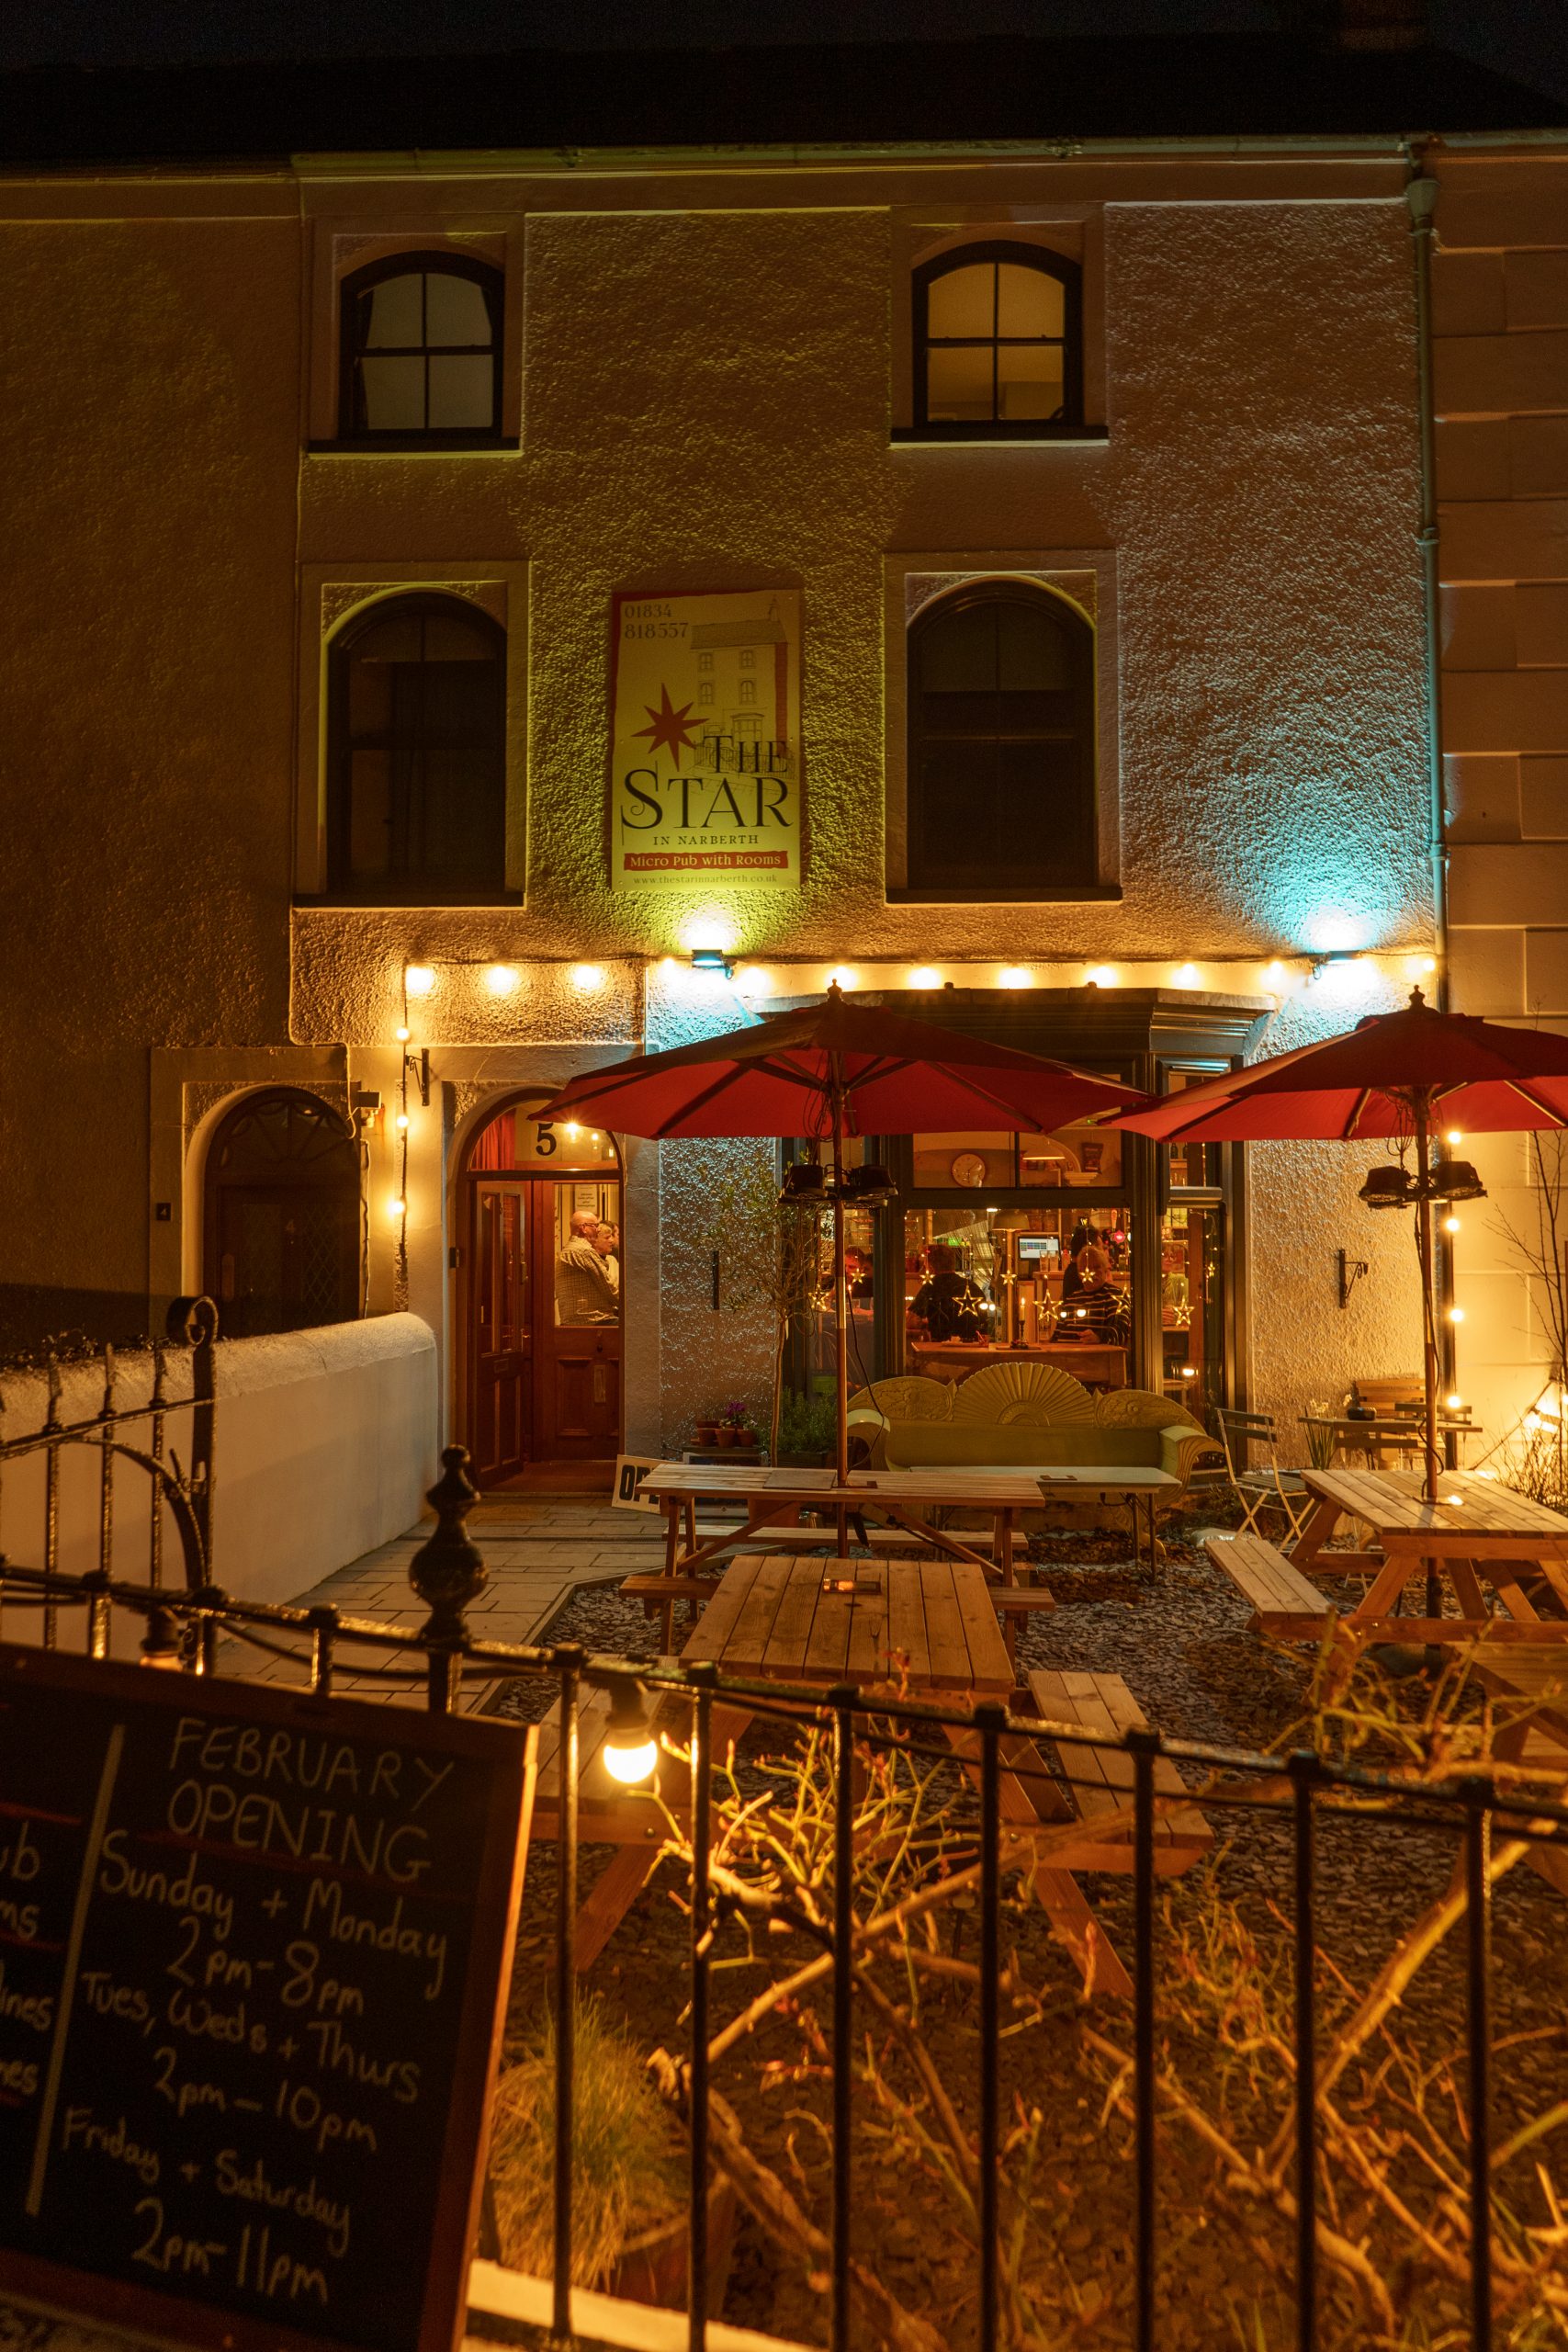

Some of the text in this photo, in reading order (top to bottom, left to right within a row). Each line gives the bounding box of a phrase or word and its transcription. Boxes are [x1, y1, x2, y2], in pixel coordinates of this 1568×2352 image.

[625, 604, 671, 618] 01834
[703, 735, 788, 774] THE
[620, 763, 795, 836] STAR
[630, 854, 781, 867] Micro Pub with Rooms
[653, 834, 759, 846] IN NARBERTH
[632, 873, 778, 885] www.thestarinnarberth.co.uk
[536, 1122, 557, 1156] 5
[168, 1716, 456, 1812] FEBRUARY
[167, 1779, 433, 1883] OPENING
[100, 1828, 234, 1941] Sunday
[302, 1877, 448, 2001] Monday
[307, 2019, 422, 2104] Thurs
[61, 2105, 161, 2186] Friday
[214, 2148, 352, 2259] Saturday
